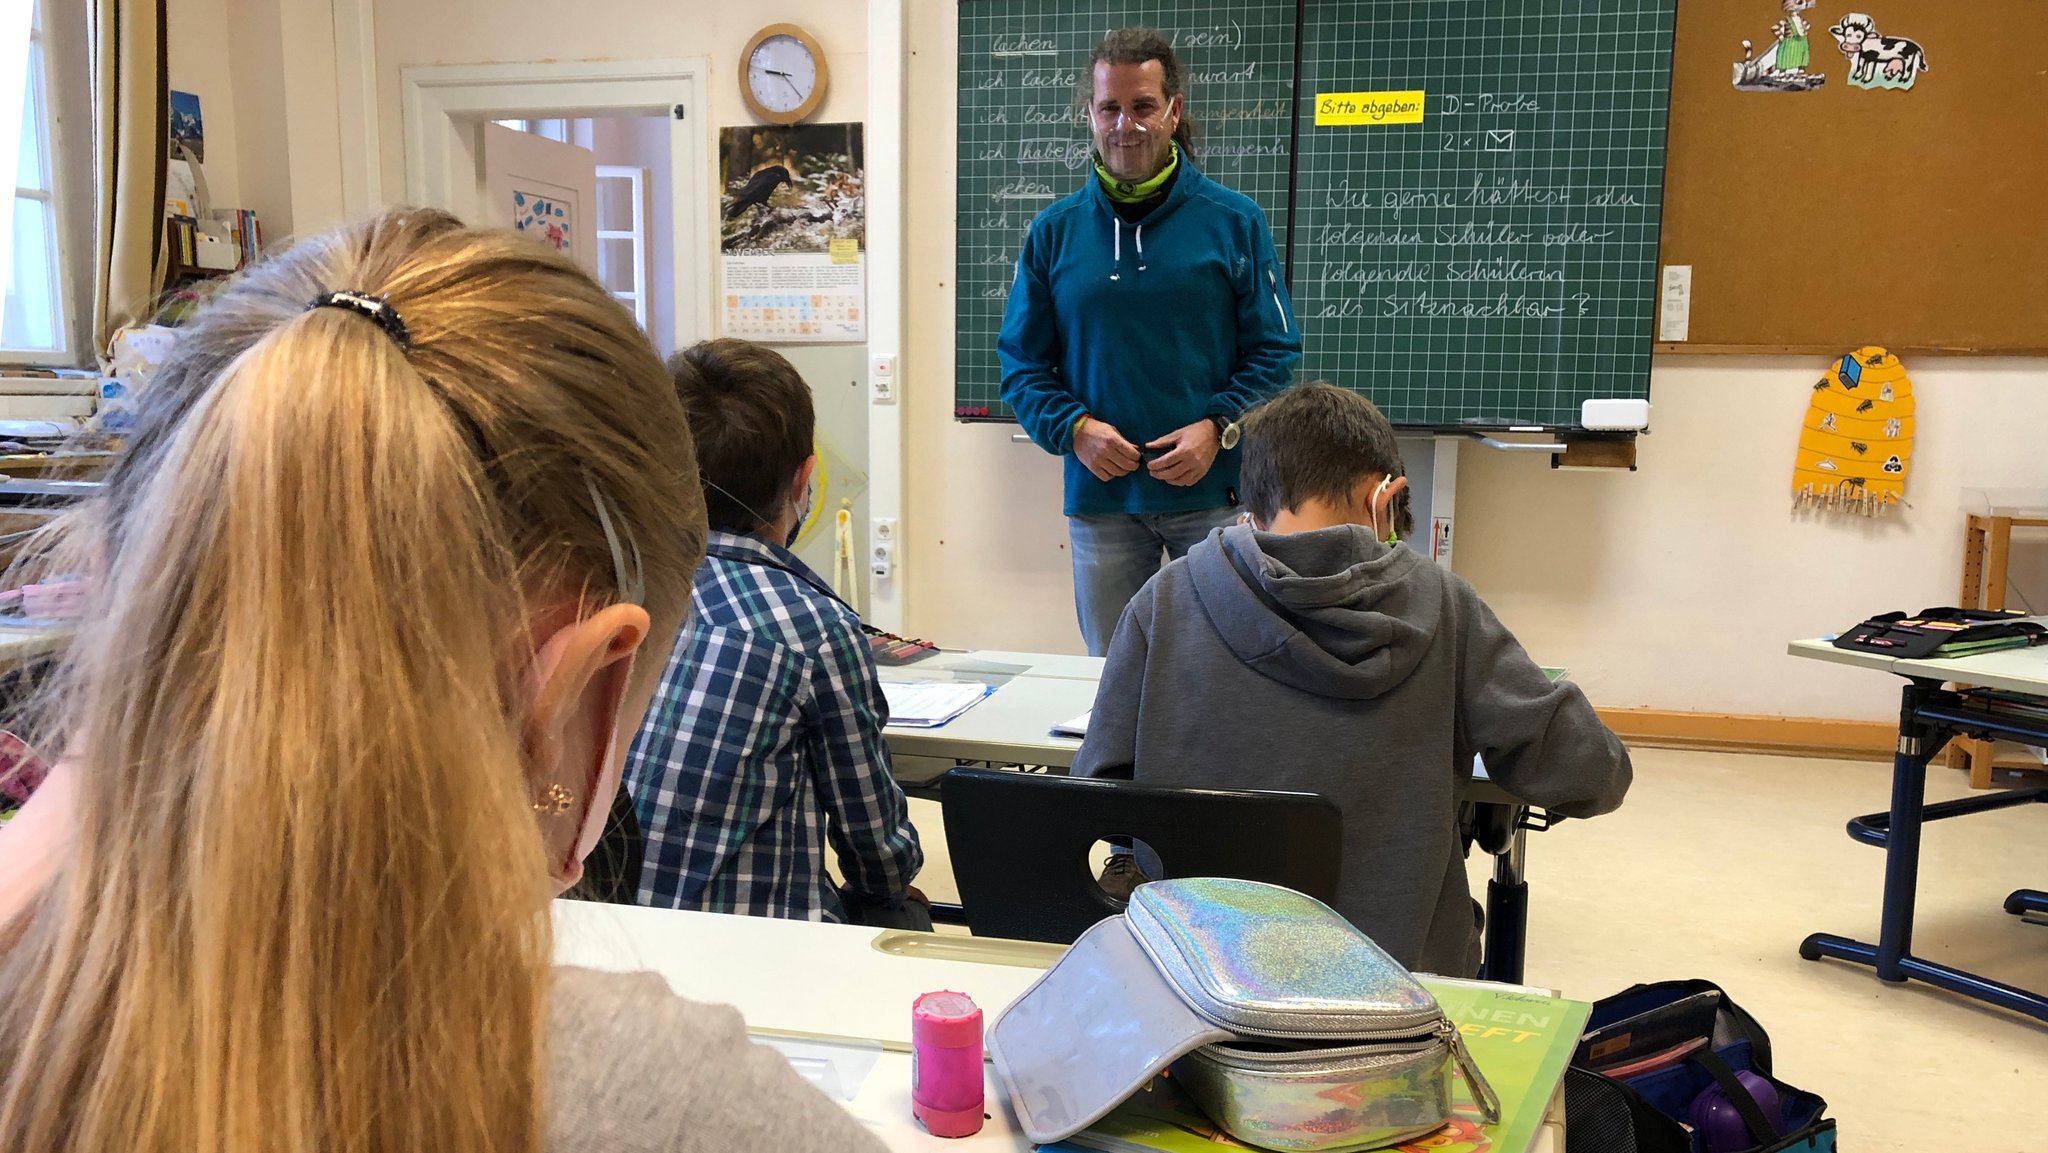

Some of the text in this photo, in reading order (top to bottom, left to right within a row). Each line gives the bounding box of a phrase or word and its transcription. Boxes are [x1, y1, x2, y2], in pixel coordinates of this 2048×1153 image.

[992, 33, 1058, 52] lachen
[978, 61, 1256, 89] ich lache nwart
[980, 106, 1008, 123] ich
[1320, 98, 1420, 121] Bitte abgeben:
[979, 140, 1004, 160] ich
[1021, 140, 1067, 160] habe
[1443, 133, 1456, 151] 2
[991, 175, 1053, 203] gehen
[1325, 172, 1642, 220] Wie gerne hättest du
[980, 207, 1010, 229] ich
[1316, 220, 1614, 257] folgenden Schüler oder
[725, 247, 775, 257] NOVEMBER
[980, 245, 1012, 265] ich
[981, 280, 1009, 298] ich
[1319, 256, 1566, 300] folgende Schülerin
[1315, 298, 1364, 319] als
[1384, 291, 1567, 318] Sitznachbar
[1454, 1021, 1542, 1044] EFT
